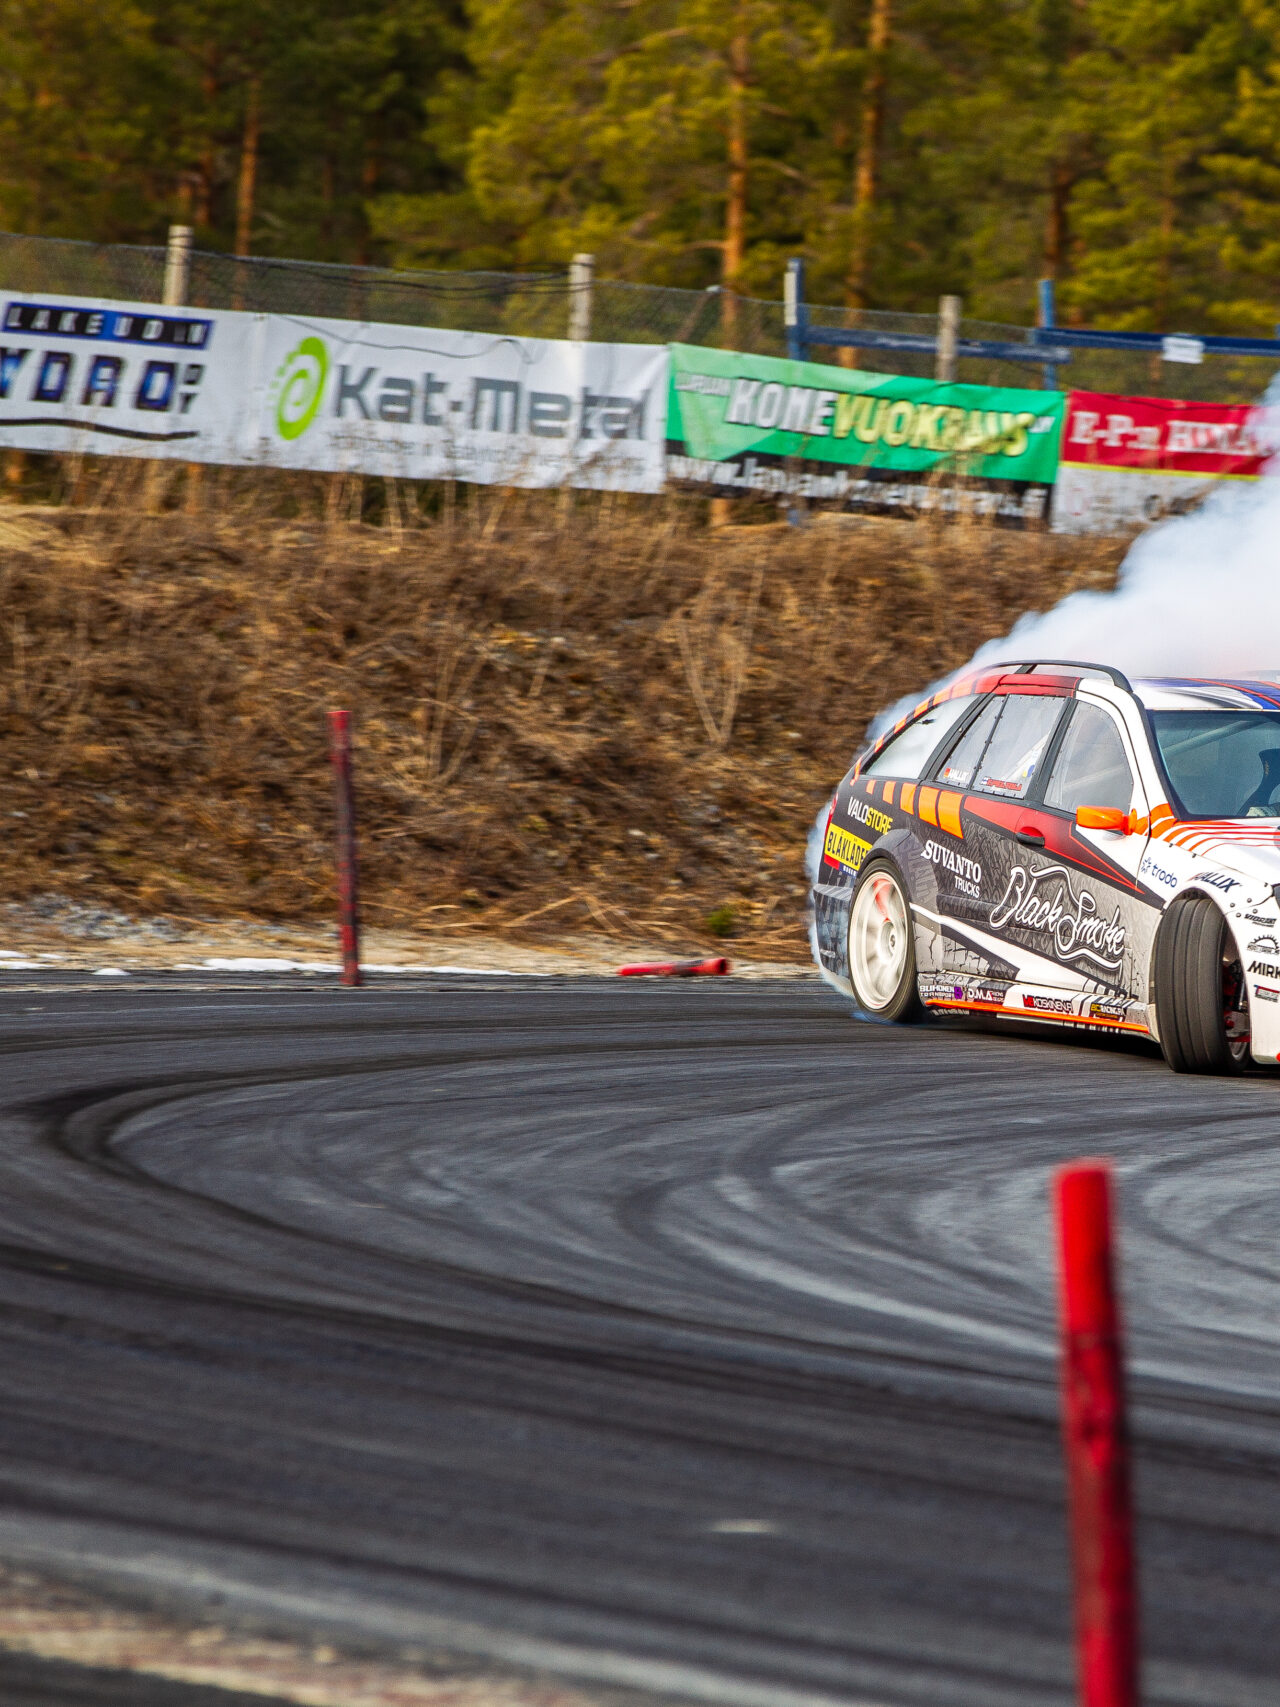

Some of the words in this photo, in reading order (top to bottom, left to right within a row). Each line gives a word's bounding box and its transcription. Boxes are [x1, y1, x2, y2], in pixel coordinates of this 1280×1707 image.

[847, 796, 894, 836] VALOSTORE
[826, 830, 871, 867] BLÅKLÄDE
[921, 839, 982, 884] SUVANTO
[955, 875, 981, 899] TRUCKS
[1151, 863, 1178, 888] trodo
[990, 864, 1063, 933] Black
[1057, 890, 1126, 957] Smoke
